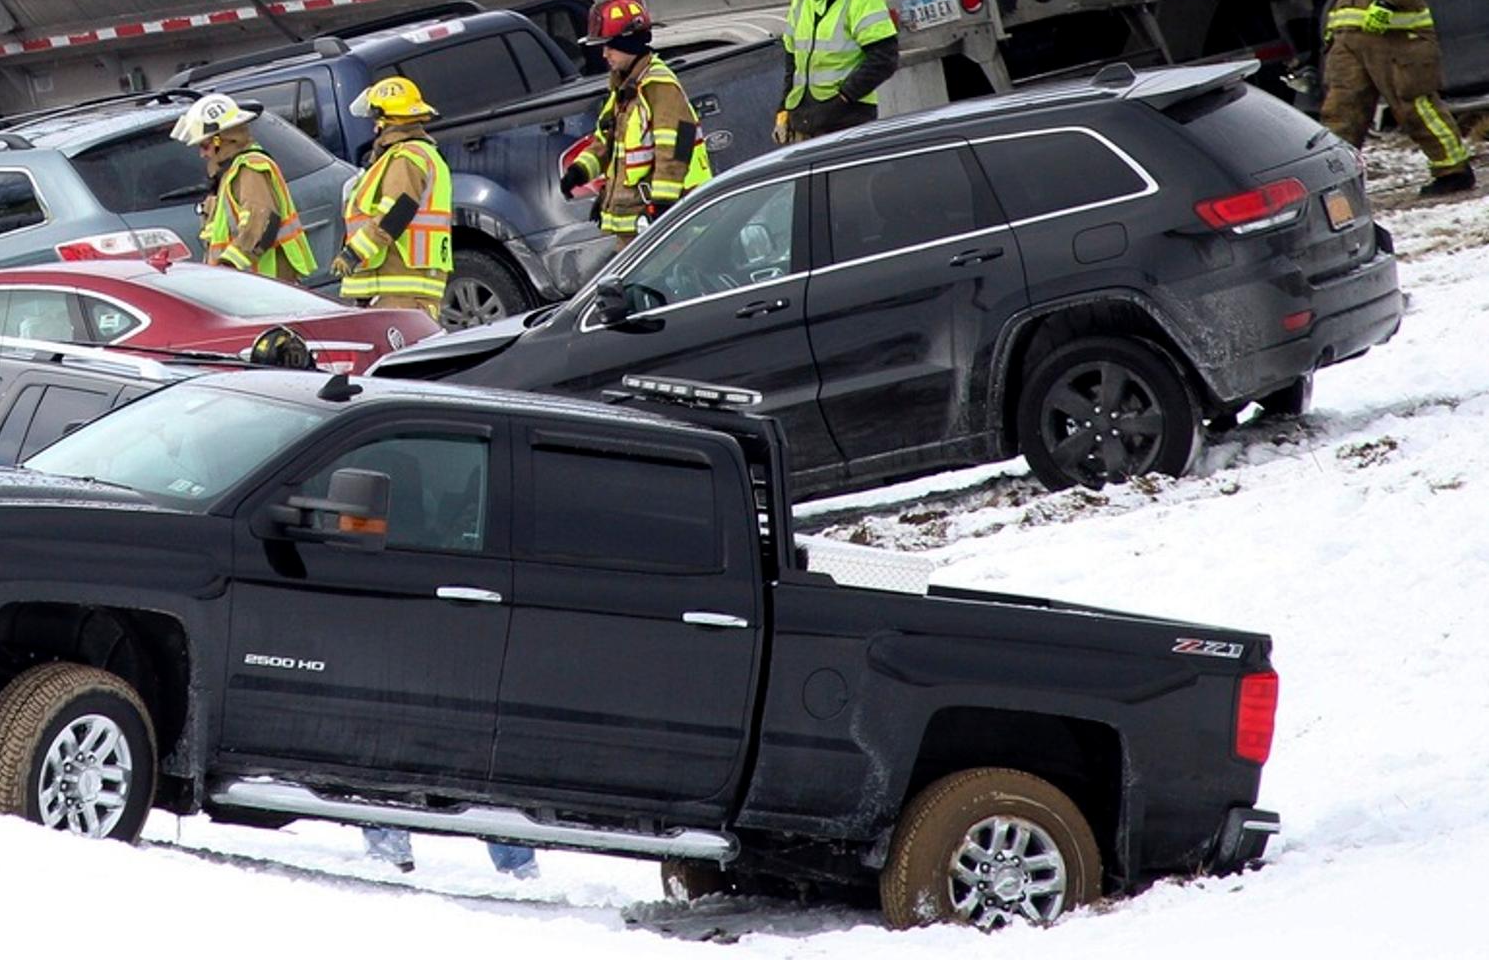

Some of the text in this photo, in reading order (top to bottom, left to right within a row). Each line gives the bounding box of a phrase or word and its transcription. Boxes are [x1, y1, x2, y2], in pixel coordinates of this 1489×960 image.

[1171, 638, 1244, 659] Z71
[244, 653, 326, 671] 2500 HD
